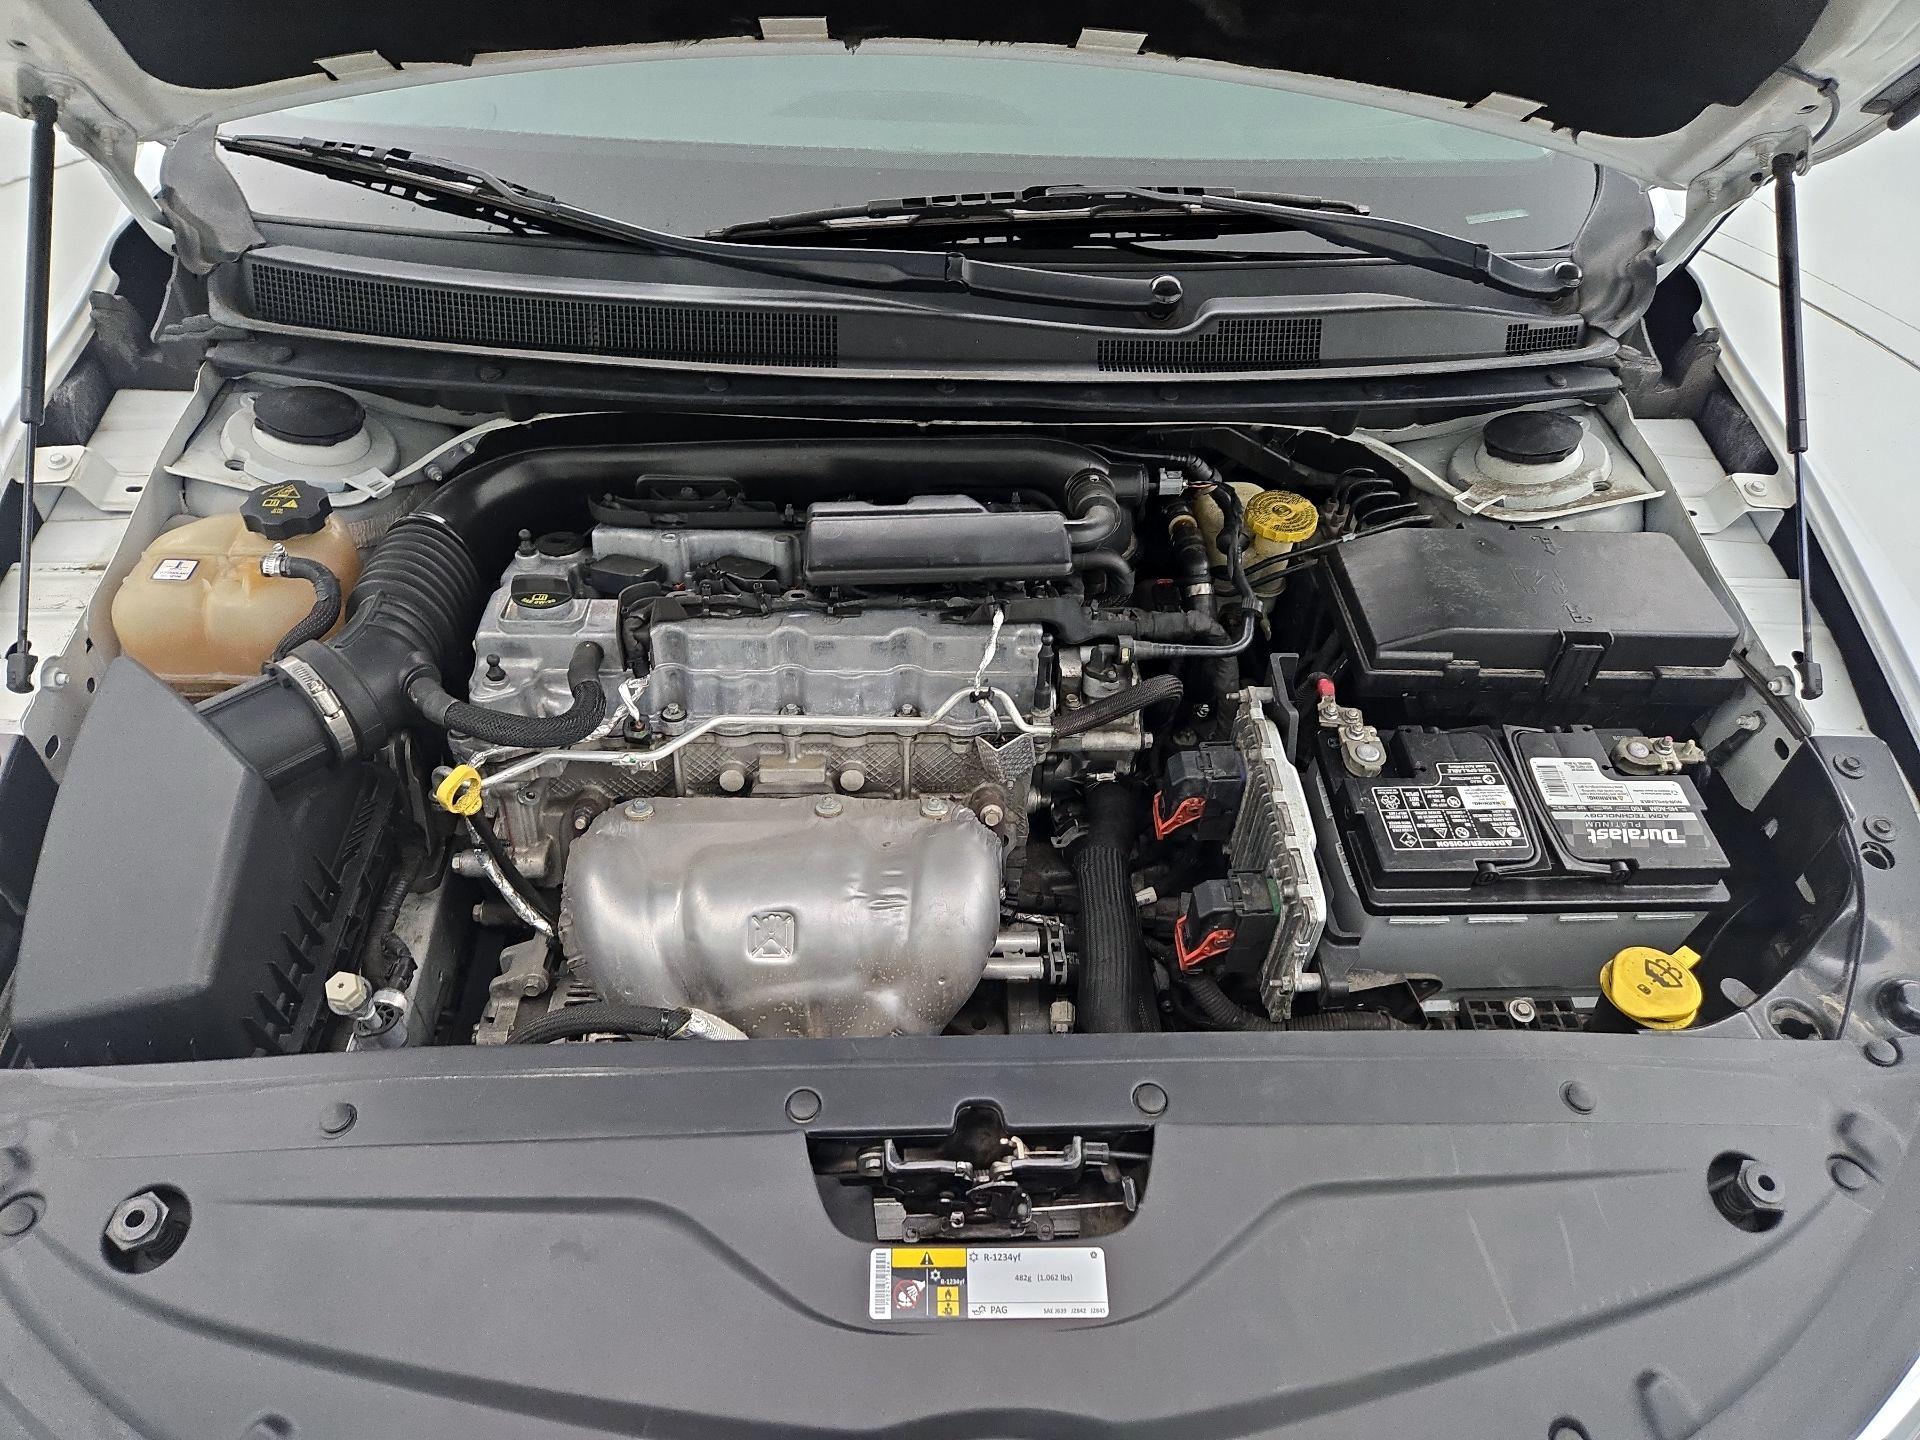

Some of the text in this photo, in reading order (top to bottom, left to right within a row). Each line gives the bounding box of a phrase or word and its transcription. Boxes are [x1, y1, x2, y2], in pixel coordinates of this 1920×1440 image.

[1586, 828, 1686, 844] Duralast
[984, 1253, 1021, 1262] R-1234yf
[1015, 1273, 1073, 1283] 482g (1.062 lbs)
[990, 1305, 1008, 1314] PAG
